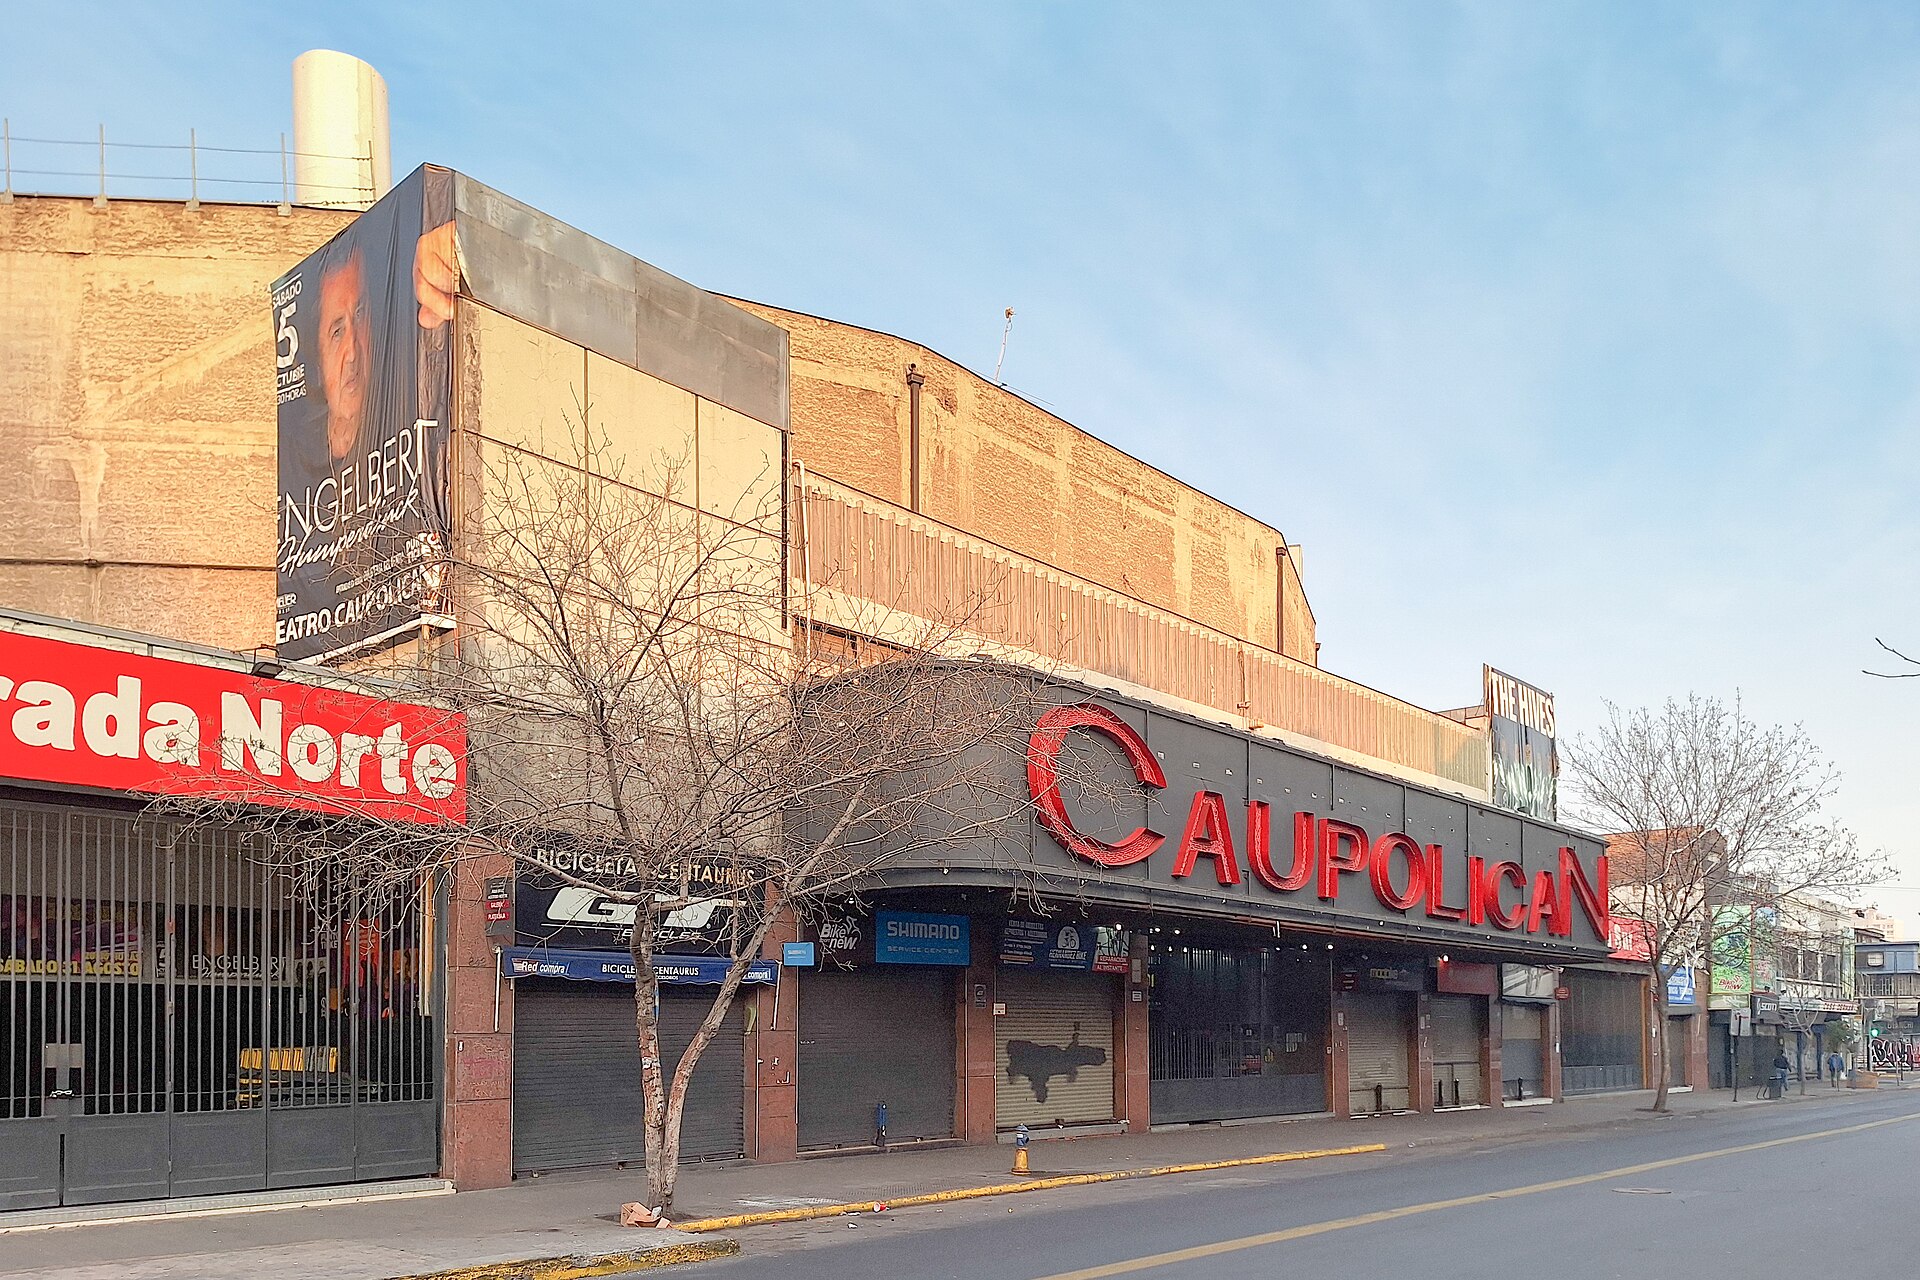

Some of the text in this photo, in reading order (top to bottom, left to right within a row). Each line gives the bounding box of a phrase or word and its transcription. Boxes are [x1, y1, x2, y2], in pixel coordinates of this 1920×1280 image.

[276, 301, 299, 369] 5
[1490, 672, 1555, 739] THE HIVES
[220, 691, 458, 800] Norte
[1026, 702, 1609, 942] CAUPOLICAN
[820, 923, 847, 939] Bike
[887, 920, 960, 940] SHIMANO
[521, 961, 539, 972] Red
[652, 966, 699, 976] CENTAURUS
